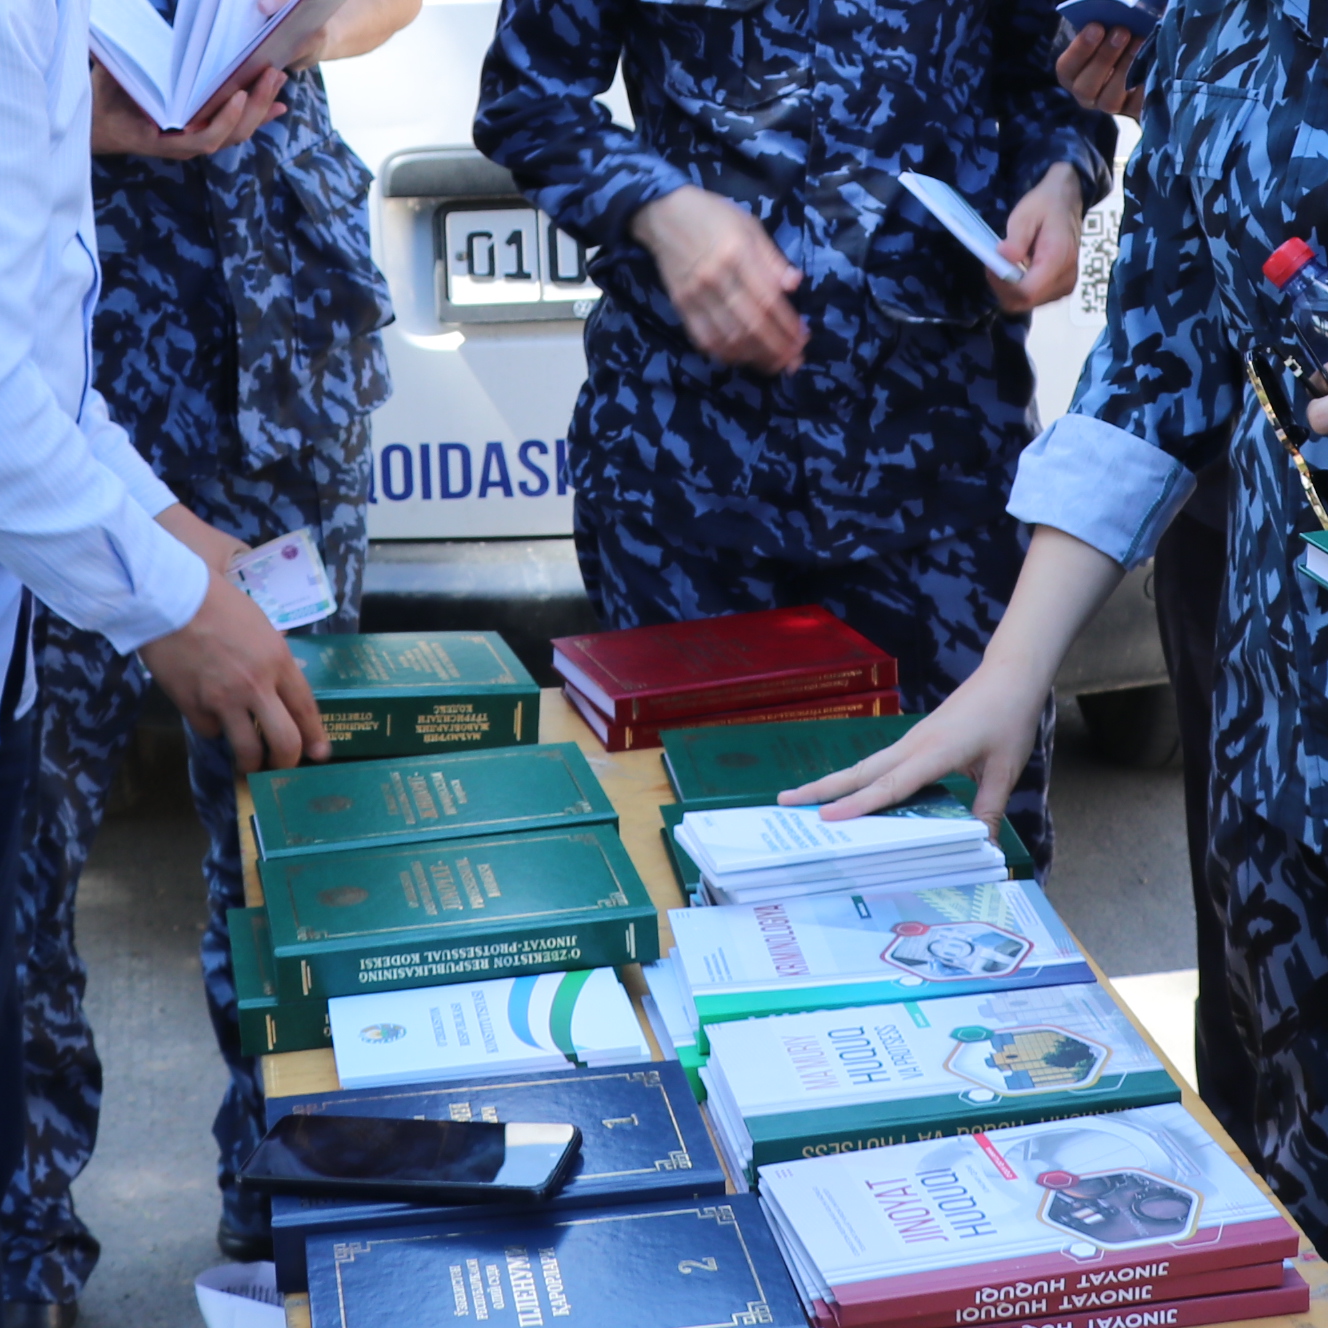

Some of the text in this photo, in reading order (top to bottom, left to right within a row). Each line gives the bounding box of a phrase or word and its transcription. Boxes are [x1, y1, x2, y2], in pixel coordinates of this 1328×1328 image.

[466, 229, 532, 283] 01
[359, 935, 579, 971] JINOYAT-PROTSESSUAL KODEKSI
[753, 904, 811, 978] KRIMINOLOGIYA
[358, 947, 582, 984] O'ZBEKISTON RESPUBLIKASINING
[827, 1026, 892, 1086] HUQUQ
[874, 1024, 918, 1067] PROTSESS
[897, 1065, 924, 1081] VA
[602, 1113, 639, 1129] 1
[864, 1177, 949, 1244] JINOYAT
[915, 1168, 997, 1239] HUQUQI
[677, 1257, 718, 1275] 2
[975, 1261, 1170, 1305] JINOYAT HUQUQI
[1058, 1284, 1153, 1310] JINOYAT
